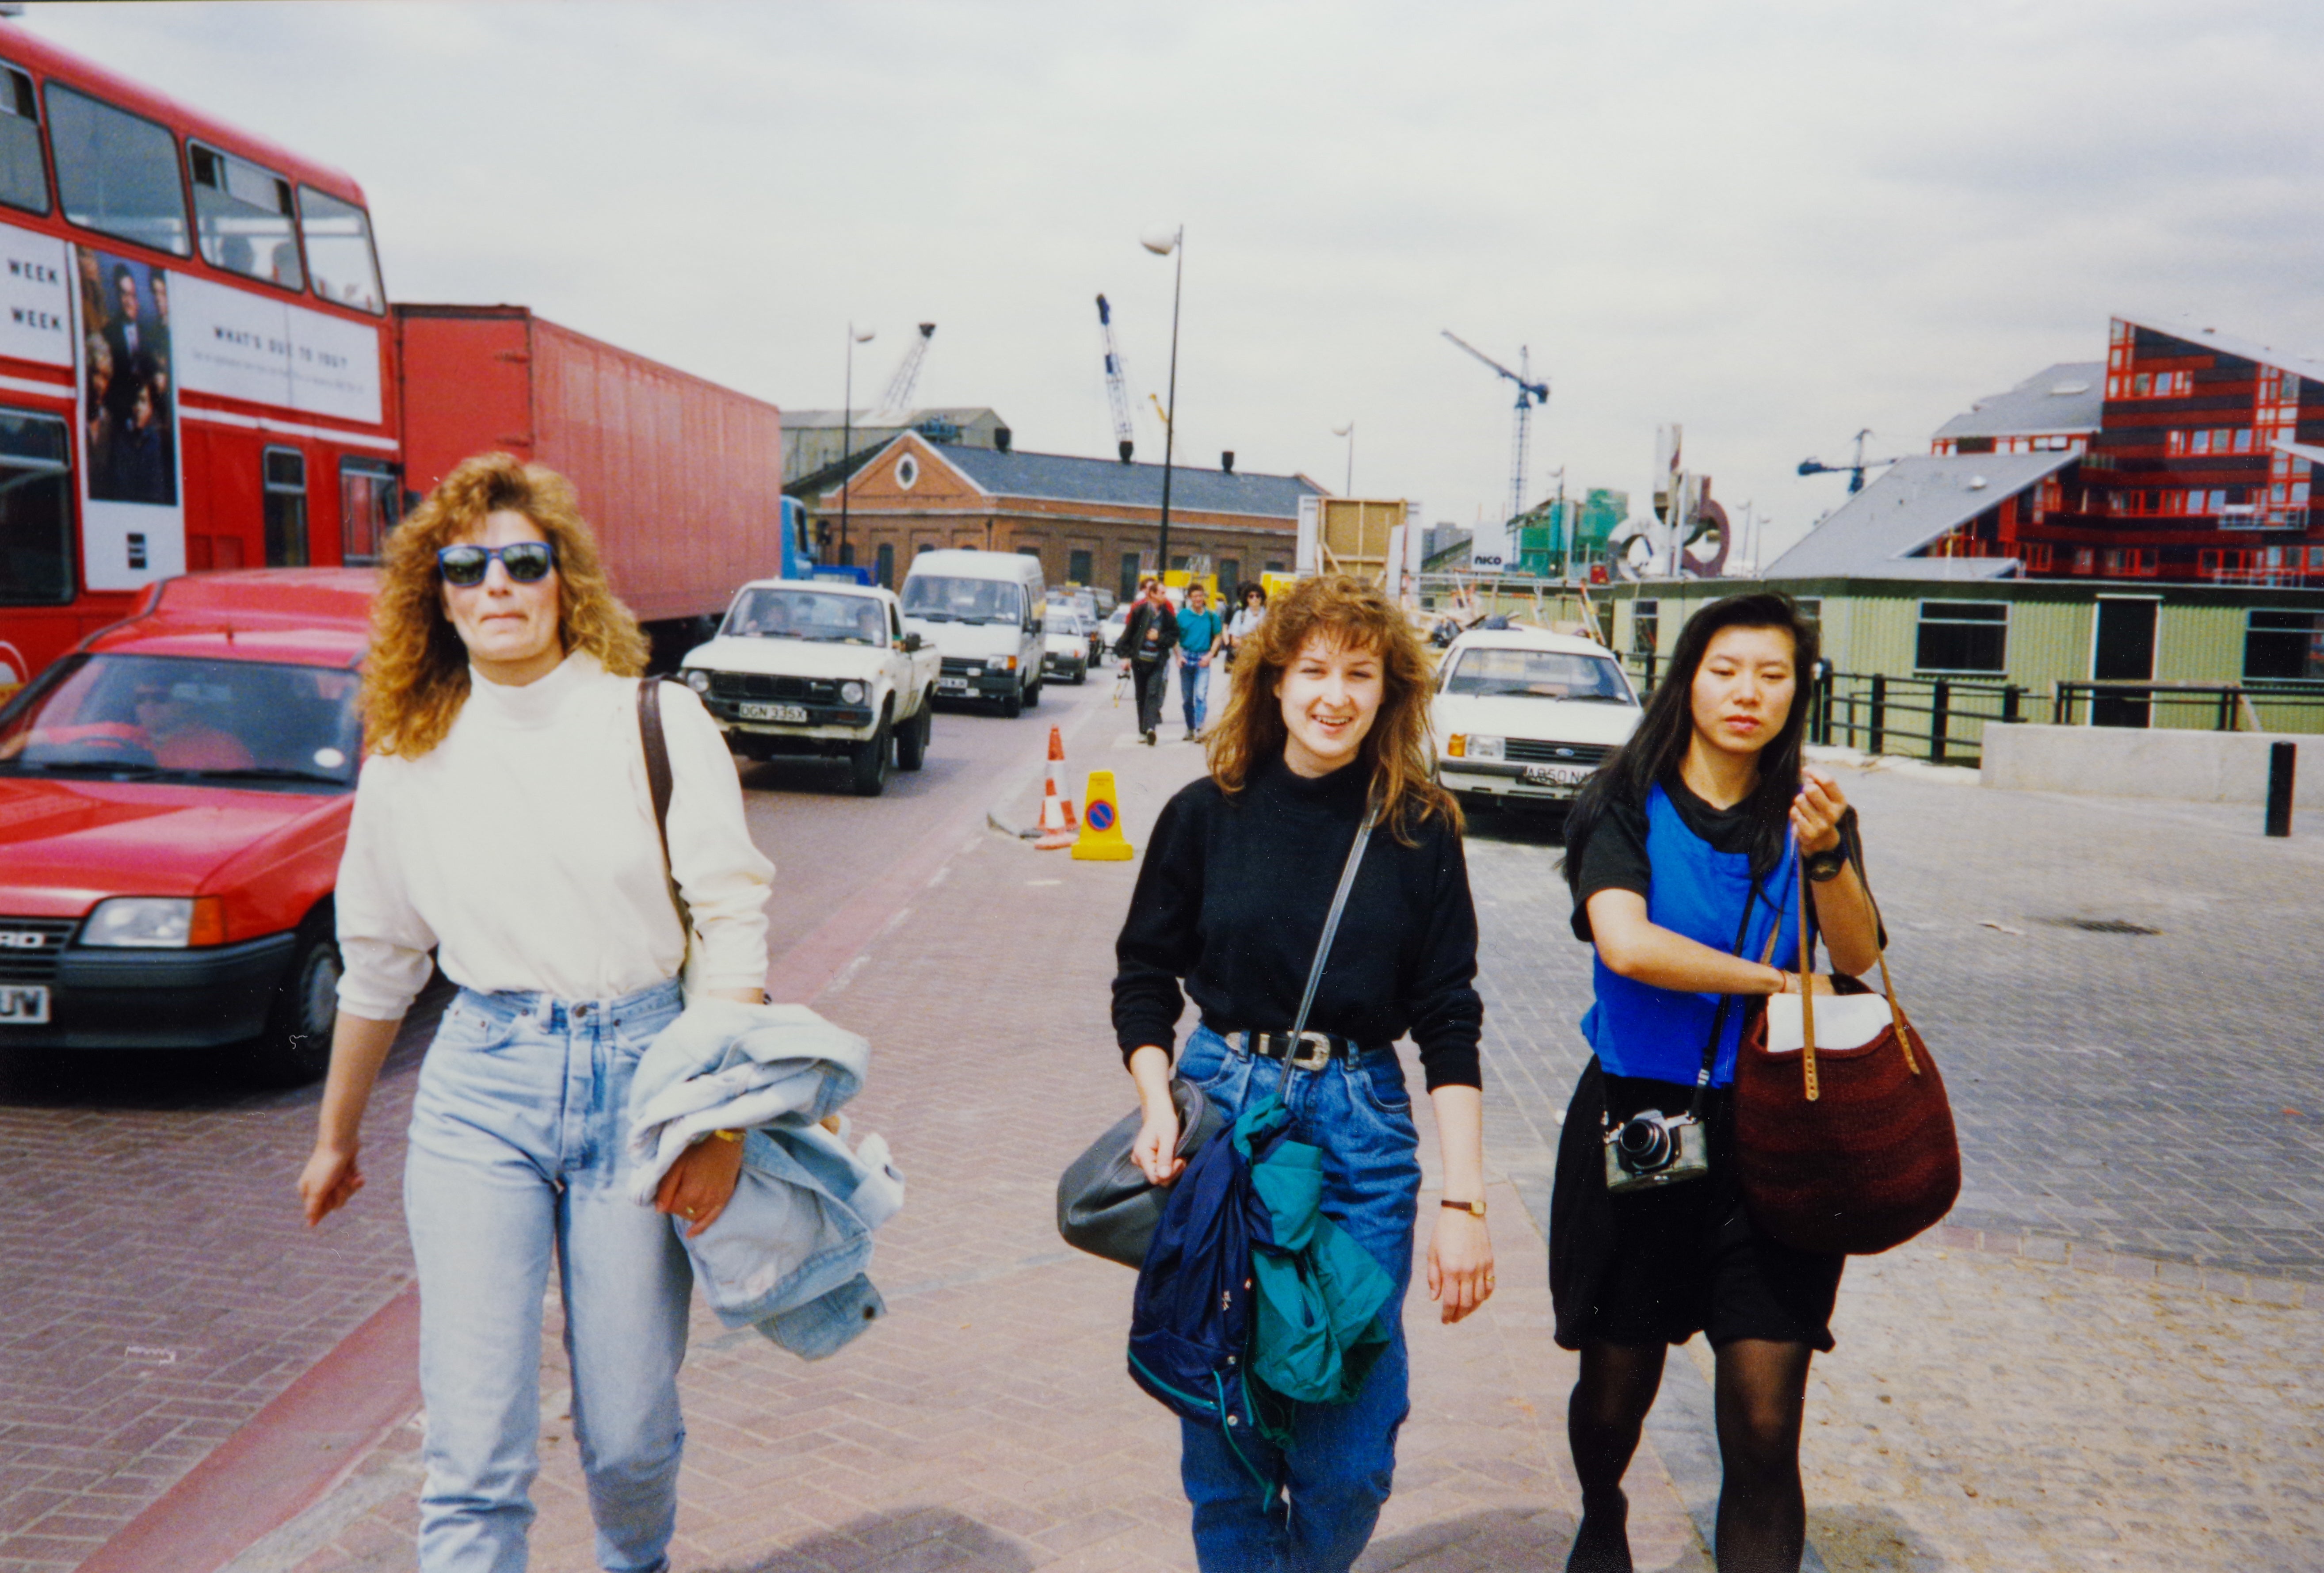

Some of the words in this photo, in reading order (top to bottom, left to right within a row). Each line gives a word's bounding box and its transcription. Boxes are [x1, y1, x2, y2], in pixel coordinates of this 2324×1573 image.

[8, 259, 58, 284] WEEK
[11, 307, 62, 332] WEEK
[214, 327, 261, 349] WHAT'S
